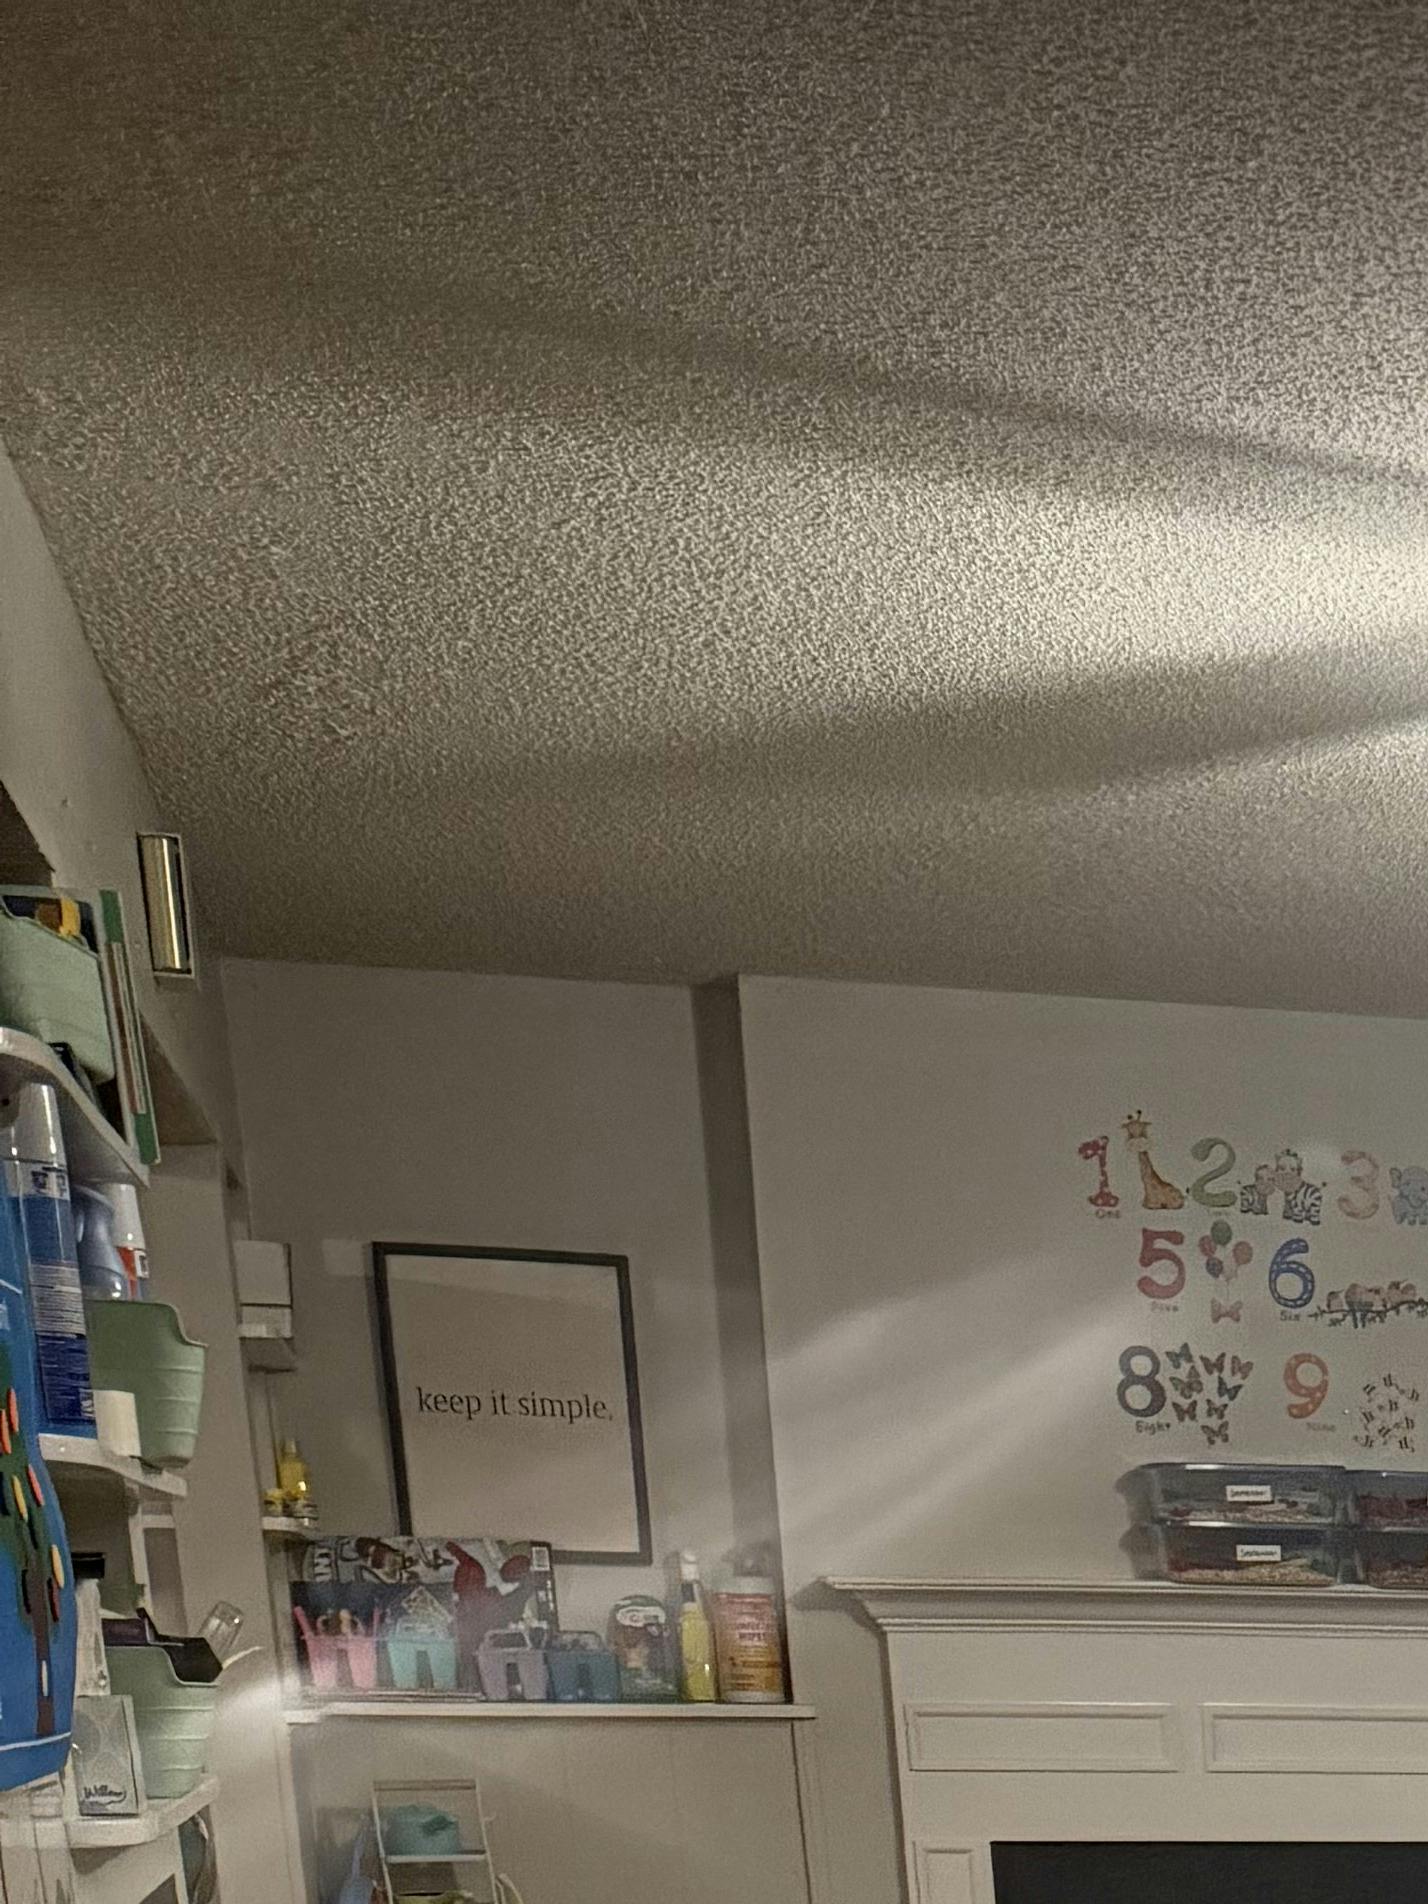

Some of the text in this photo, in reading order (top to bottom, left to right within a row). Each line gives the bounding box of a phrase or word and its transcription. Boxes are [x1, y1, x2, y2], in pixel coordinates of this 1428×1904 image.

[1077, 1135, 1120, 1208] 1
[1189, 1136, 1238, 1208] 2
[1338, 1149, 1380, 1220] 3
[1136, 1227, 1186, 1300] 5
[1268, 1237, 1316, 1309] 6
[415, 1386, 614, 1425] keep it simple.
[1116, 1345, 1167, 1418] 8
[1282, 1352, 1330, 1420] 9
